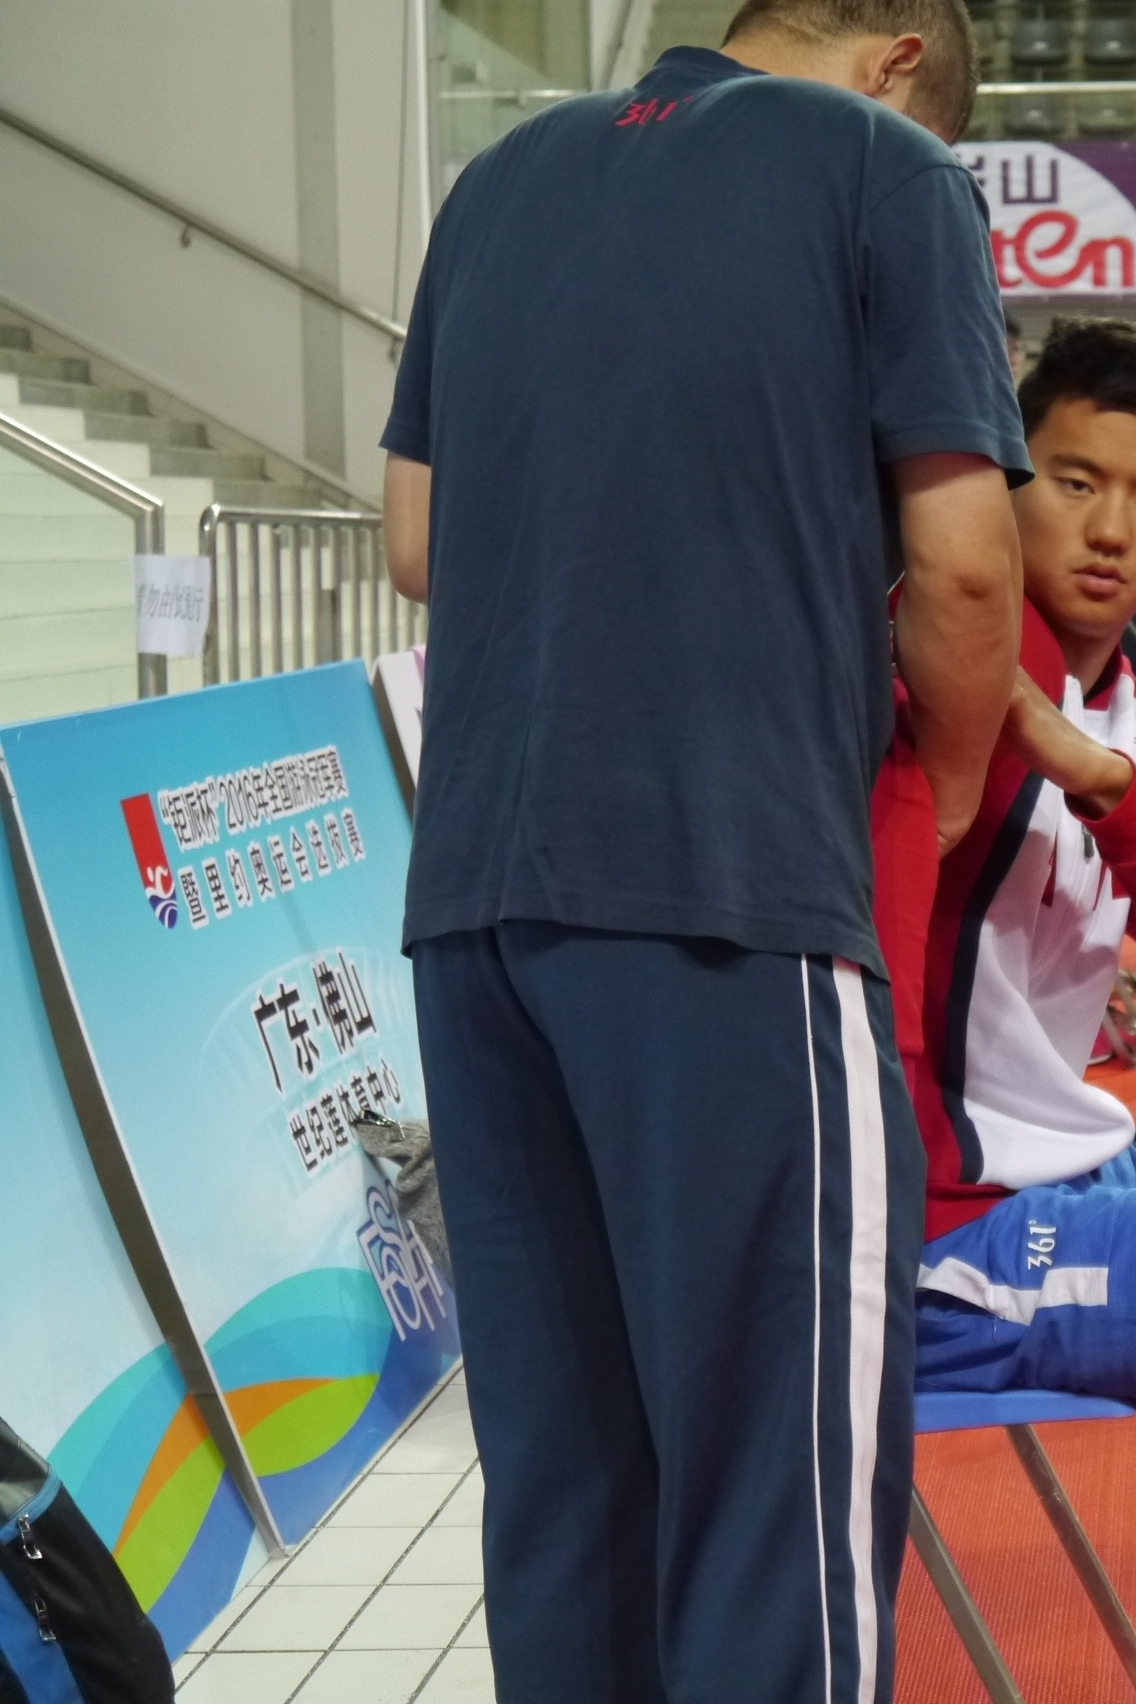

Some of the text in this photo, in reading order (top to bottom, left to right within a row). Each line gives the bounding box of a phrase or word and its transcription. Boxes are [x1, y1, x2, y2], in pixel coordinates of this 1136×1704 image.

[179, 809, 364, 925] 暨里约奥运会选拔赛
